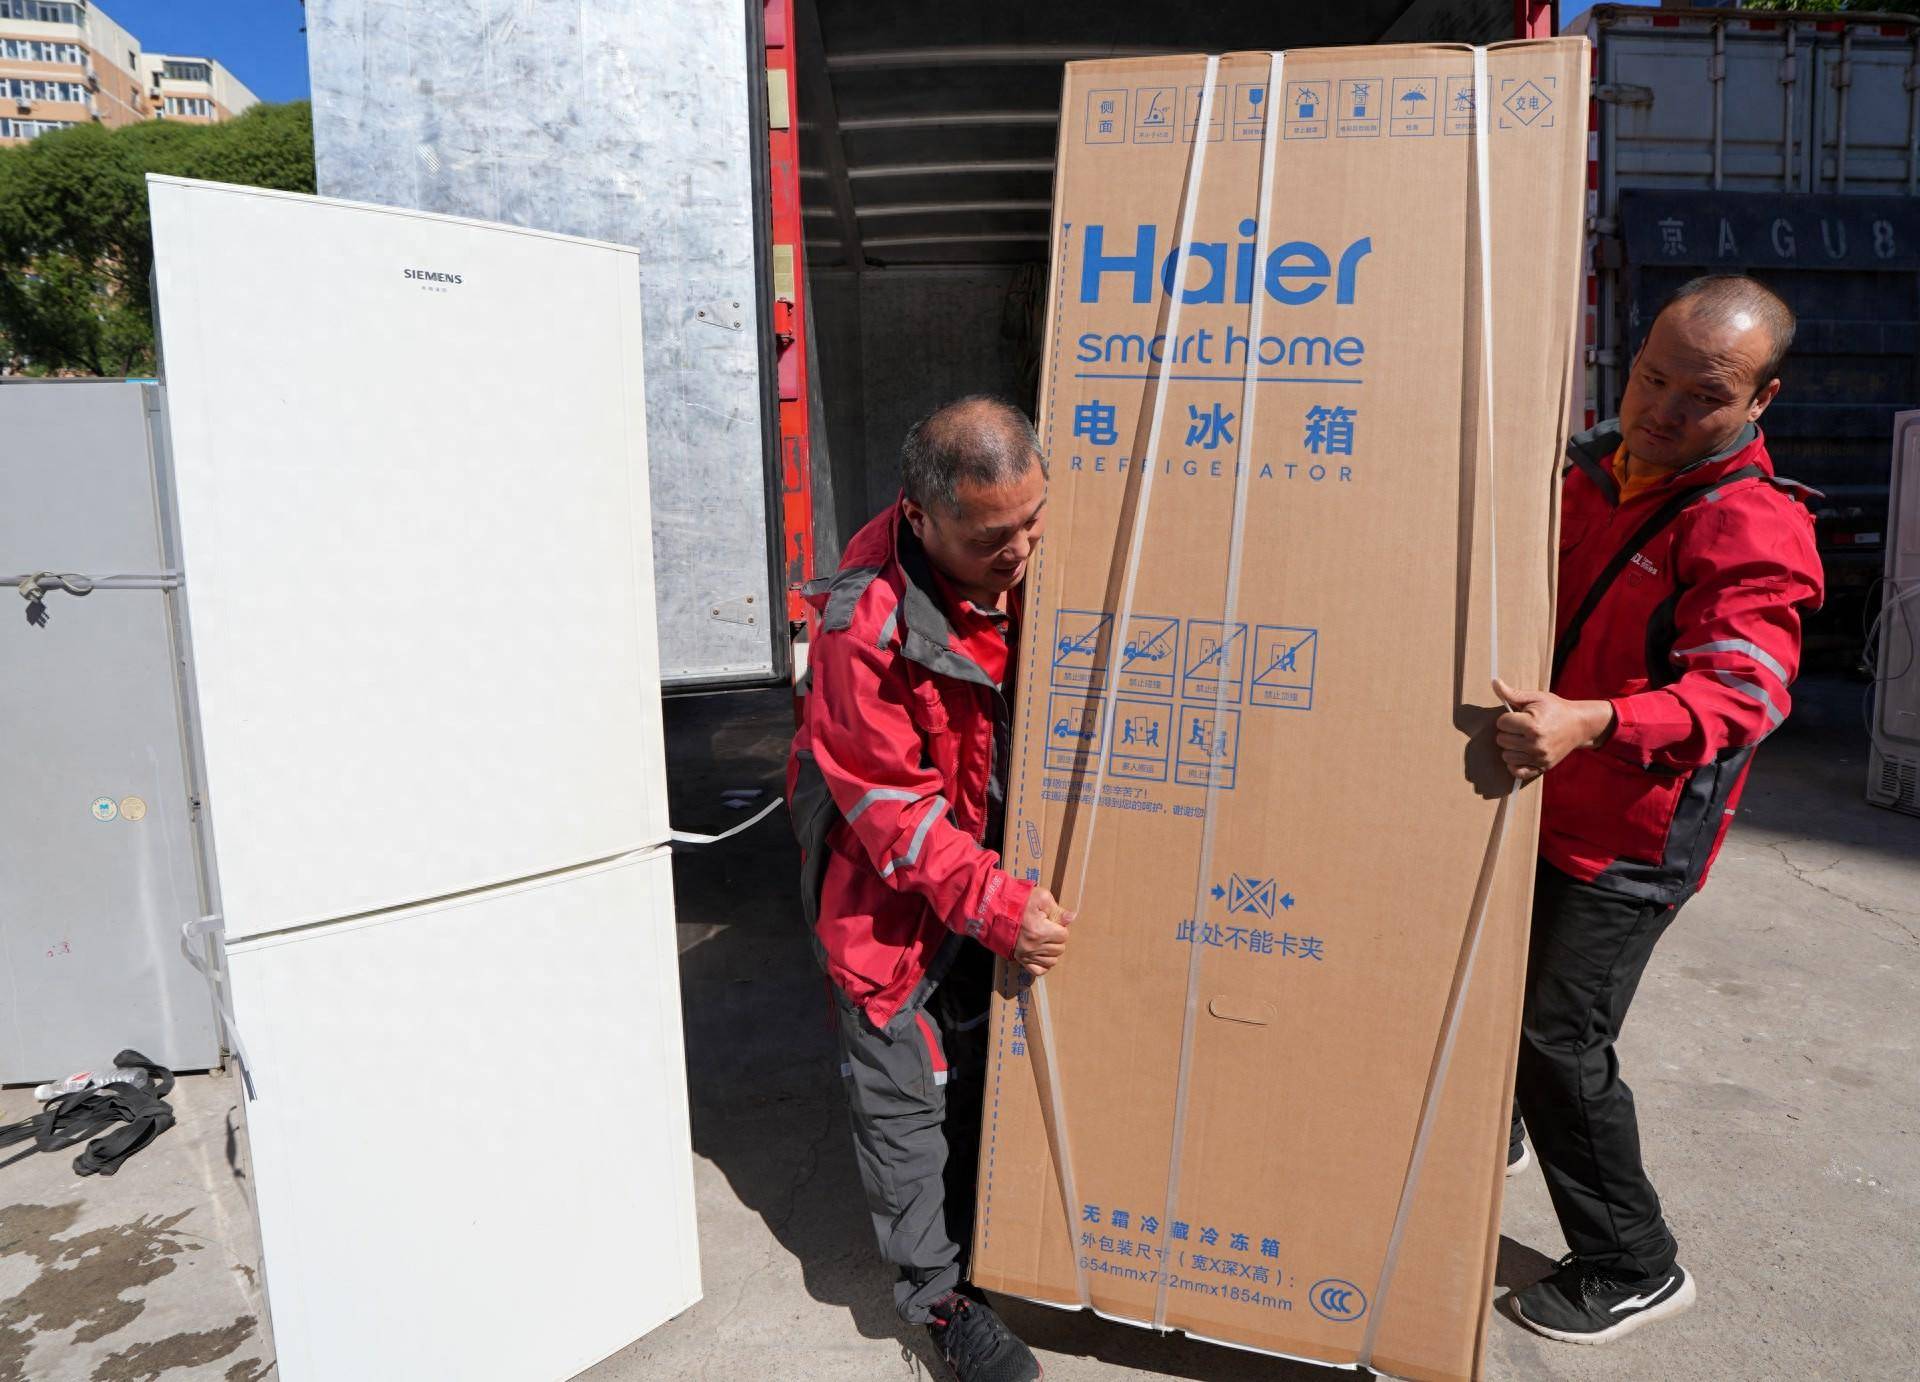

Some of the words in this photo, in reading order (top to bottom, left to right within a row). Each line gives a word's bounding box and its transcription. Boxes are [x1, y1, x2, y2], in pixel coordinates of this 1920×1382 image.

[403, 268, 463, 285] SIEMENS
[1080, 218, 1372, 305] Haier
[1076, 329, 1213, 364] smart
[1225, 326, 1365, 366] home
[1073, 400, 1358, 456] 电冰箱
[1071, 456, 1353, 482] REFIGEATOR
[1175, 919, 1324, 961] 此处不能卡夹
[1082, 1204, 1281, 1258] 无霜冷藏冷冻箱
